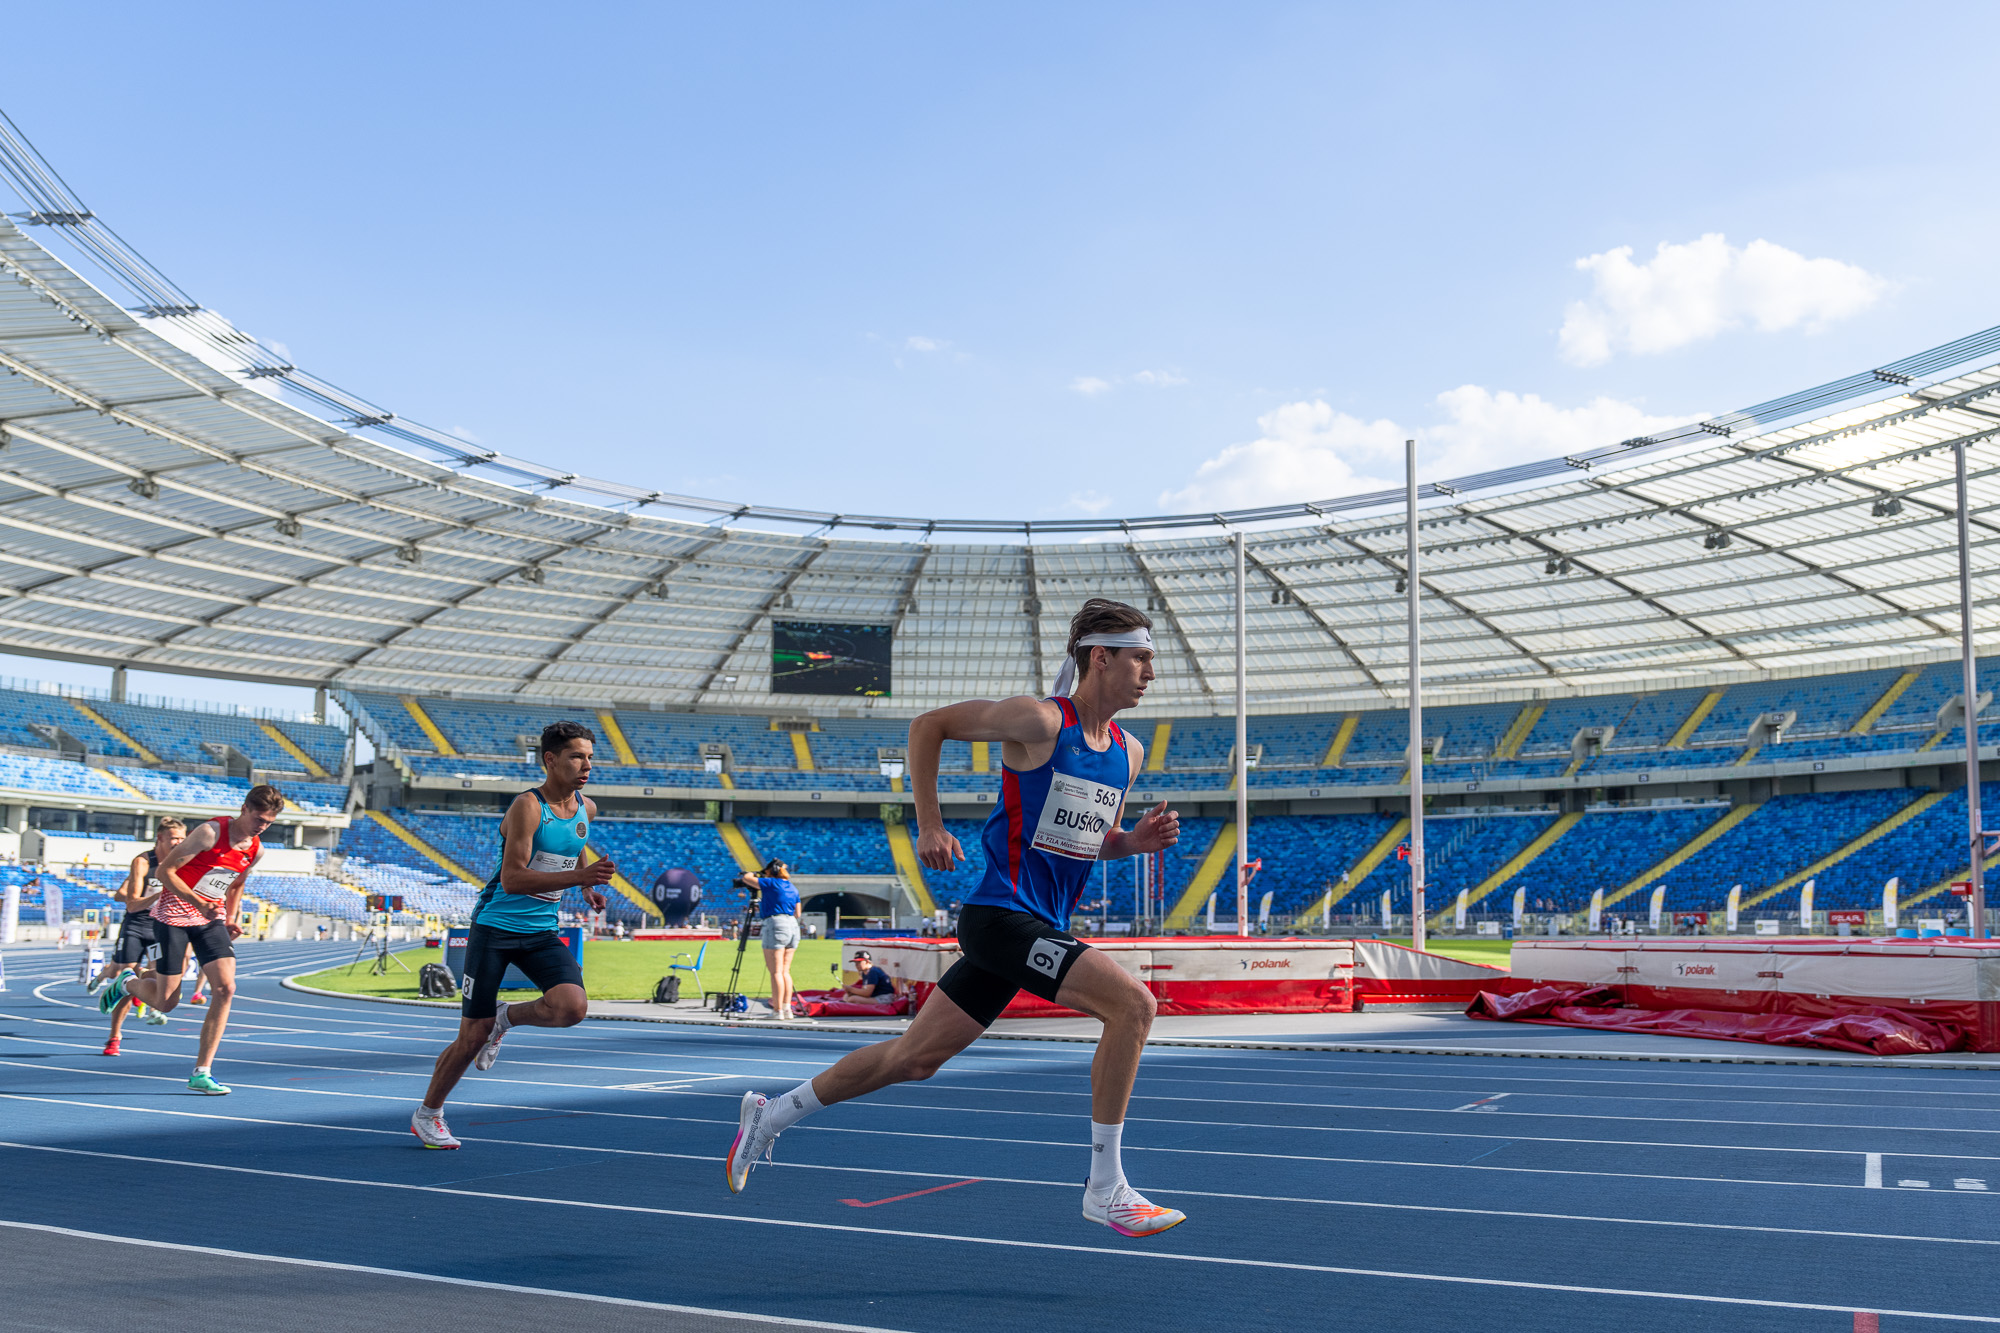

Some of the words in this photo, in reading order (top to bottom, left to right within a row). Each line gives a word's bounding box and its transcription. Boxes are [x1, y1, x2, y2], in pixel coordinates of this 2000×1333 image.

[1094, 788, 1116, 807] 563
[1053, 808, 1105, 834] BUŚKO
[1045, 836, 1059, 845] PZLA
[561, 859, 576, 869] 585
[150, 945, 158, 959] 7
[1250, 958, 1291, 971] polanik
[1684, 964, 1716, 976] polanik
[463, 977, 471, 996] 8
